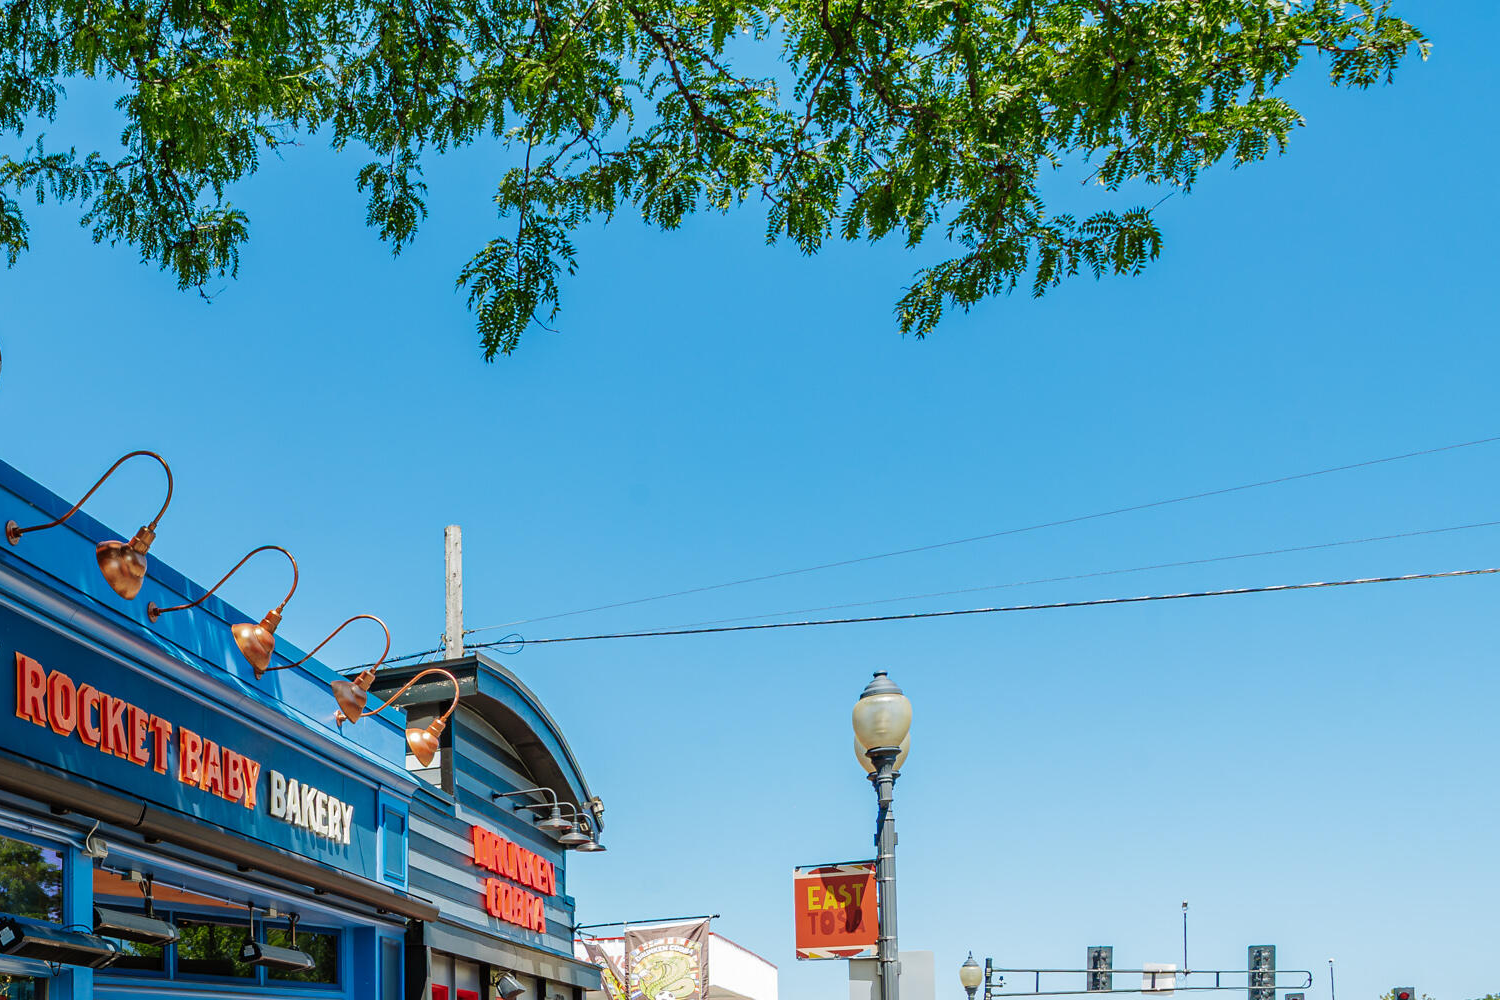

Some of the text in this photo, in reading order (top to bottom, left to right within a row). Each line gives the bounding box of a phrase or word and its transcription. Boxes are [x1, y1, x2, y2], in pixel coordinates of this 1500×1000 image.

[14, 651, 173, 775] ROCKET
[177, 725, 261, 810] BABY
[268, 769, 354, 845] BAKERY
[472, 824, 557, 897] DRUNKEN
[485, 877, 547, 934] COBRA
[807, 883, 864, 911] EAST
[807, 909, 866, 936] TOSA
